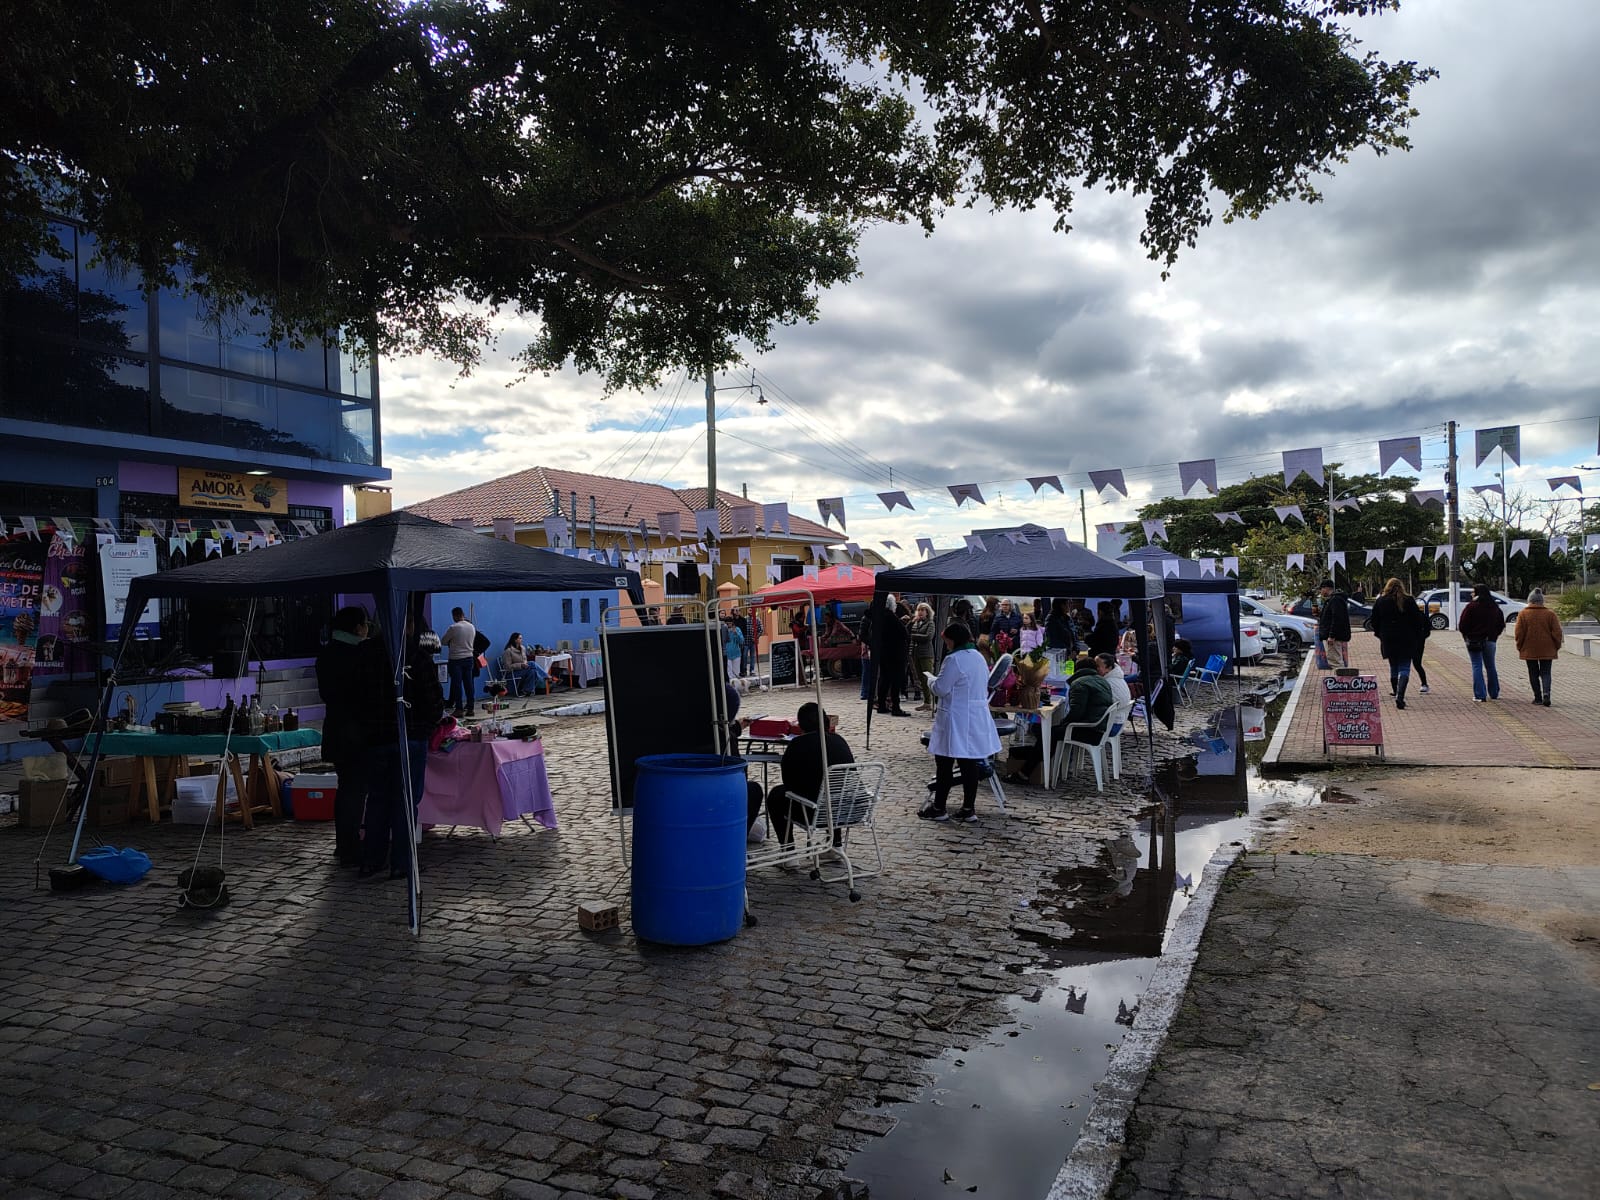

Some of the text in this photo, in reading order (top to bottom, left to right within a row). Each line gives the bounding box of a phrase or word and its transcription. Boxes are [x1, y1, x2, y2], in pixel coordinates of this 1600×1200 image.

[96, 477, 114, 487] 504
[13, 558, 42, 571] Cheia
[21, 584, 40, 597] DE
[1324, 677, 1376, 691] Boca Cheia
[1337, 723, 1359, 732] Buffet
[1338, 731, 1370, 739] Sorvetes
